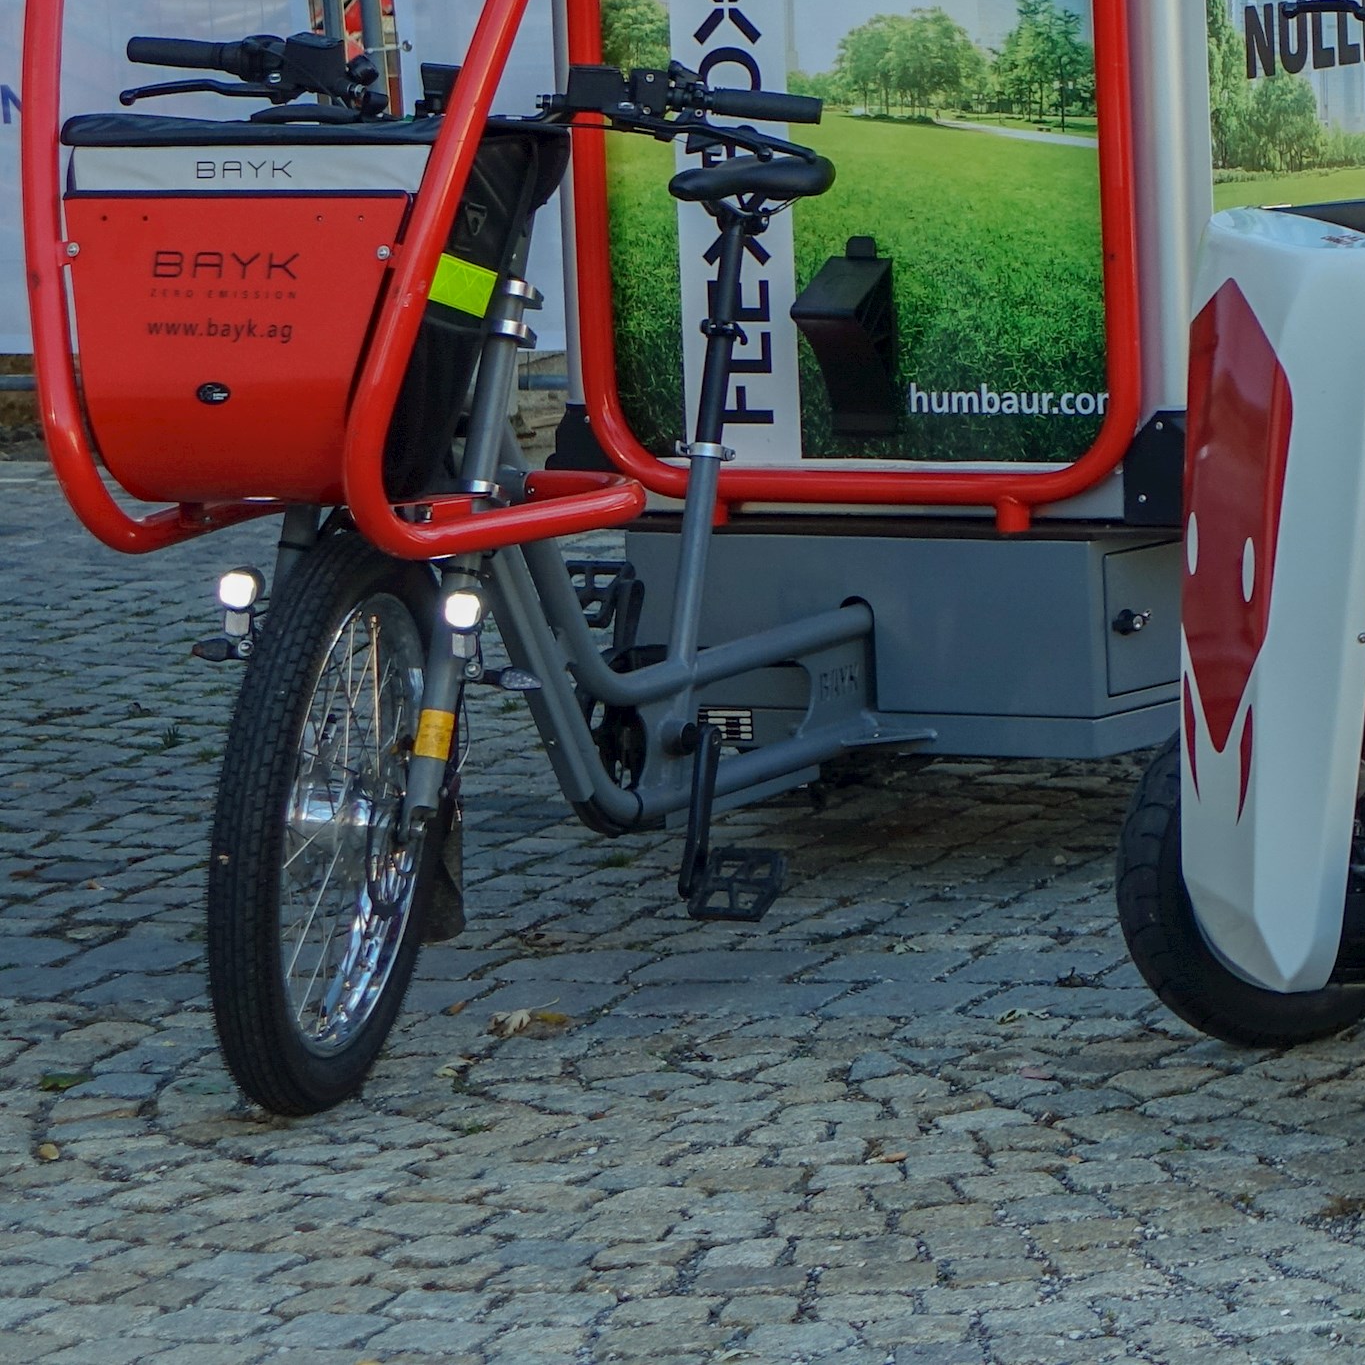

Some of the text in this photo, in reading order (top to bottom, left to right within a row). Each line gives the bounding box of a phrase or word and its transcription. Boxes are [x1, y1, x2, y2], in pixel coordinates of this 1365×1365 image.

[196, 160, 293, 179] BAYK
[153, 251, 300, 280] BAYK
[150, 288, 297, 300] ZERO EMISSION
[147, 318, 293, 344] www.bayk.ag
